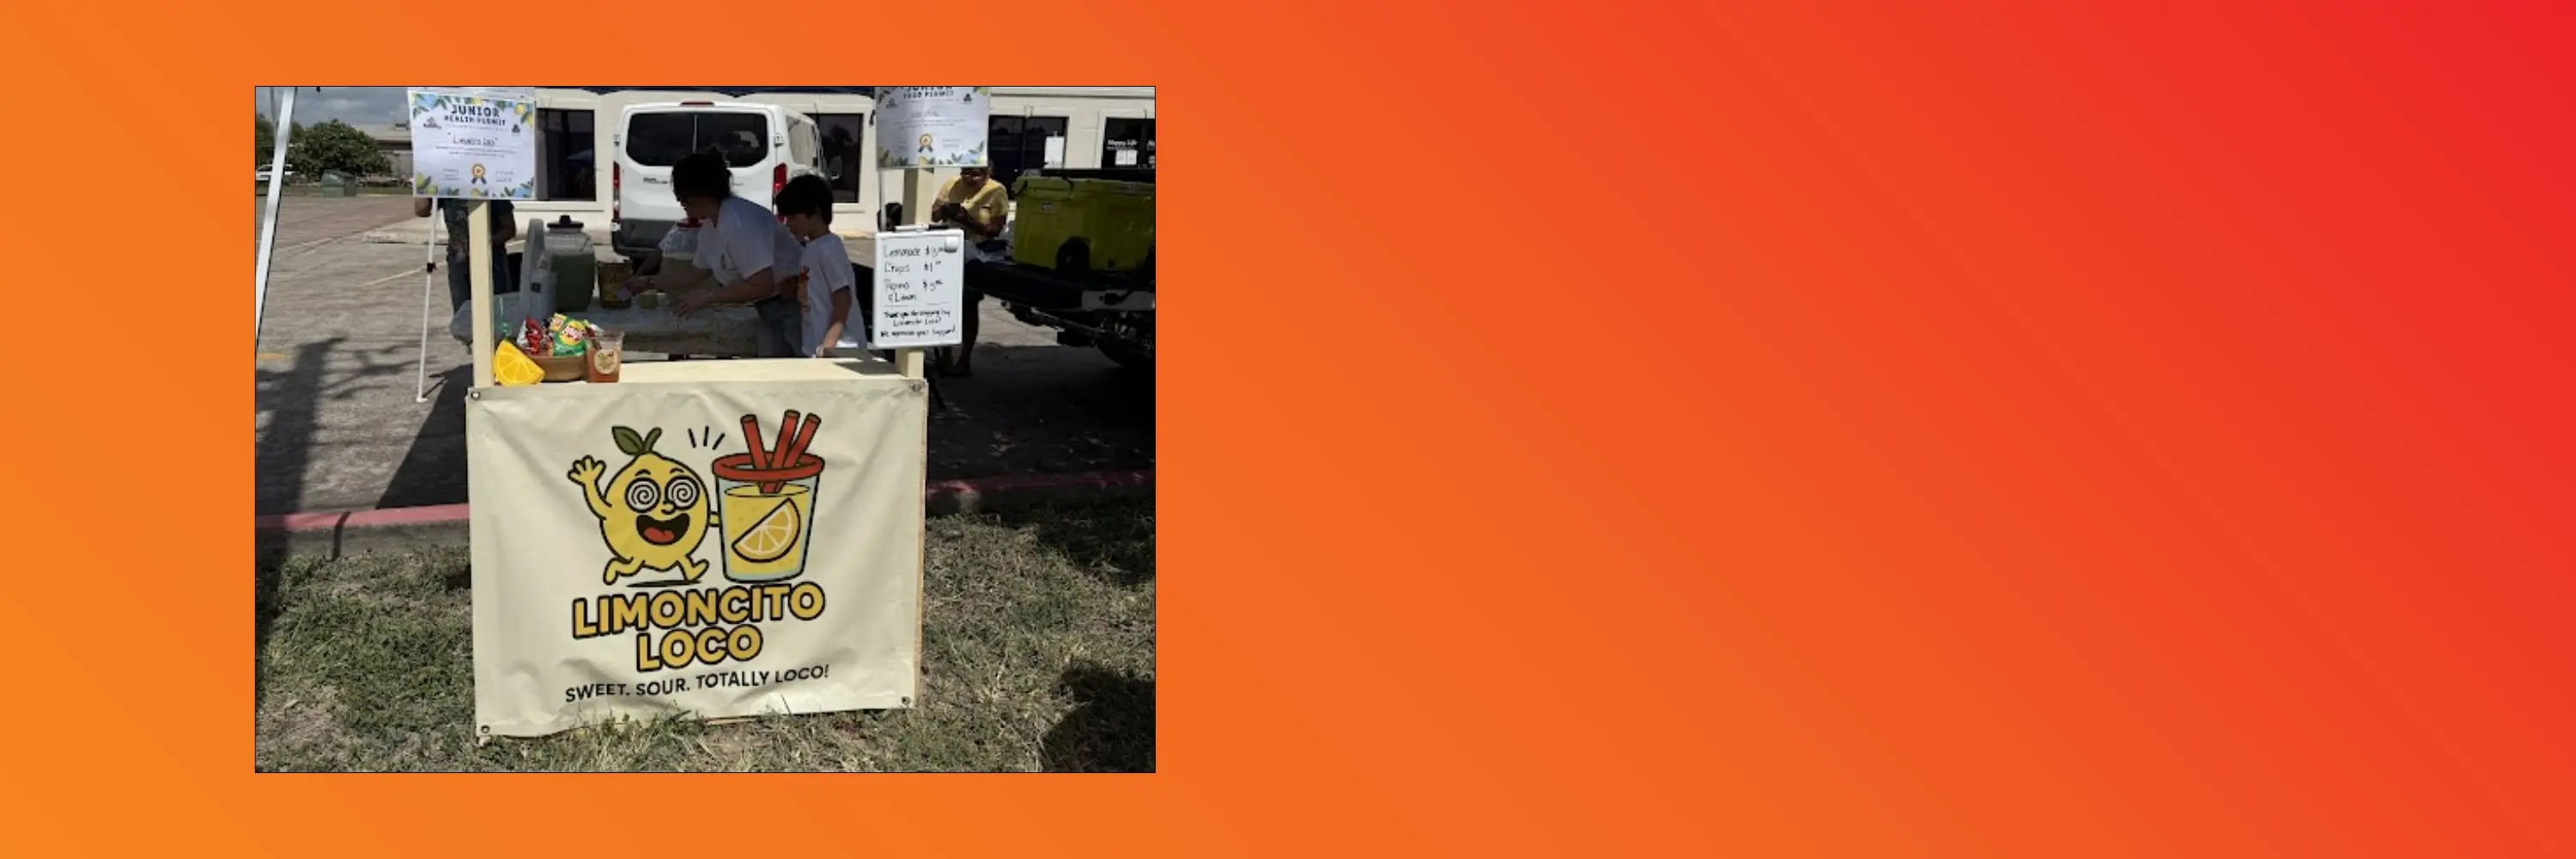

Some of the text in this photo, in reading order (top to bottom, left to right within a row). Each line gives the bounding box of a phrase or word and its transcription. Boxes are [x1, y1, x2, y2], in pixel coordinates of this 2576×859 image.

[444, 114, 475, 124] HEALTH
[477, 118, 506, 126] PERMIT
[452, 104, 500, 117] JUNIOR
[884, 245, 920, 258] Lemonade
[573, 582, 825, 638] LIMONCITO
[636, 624, 763, 672] LOCO
[566, 664, 829, 703] SWEET. SOUR. TOTALLY LOCO!
